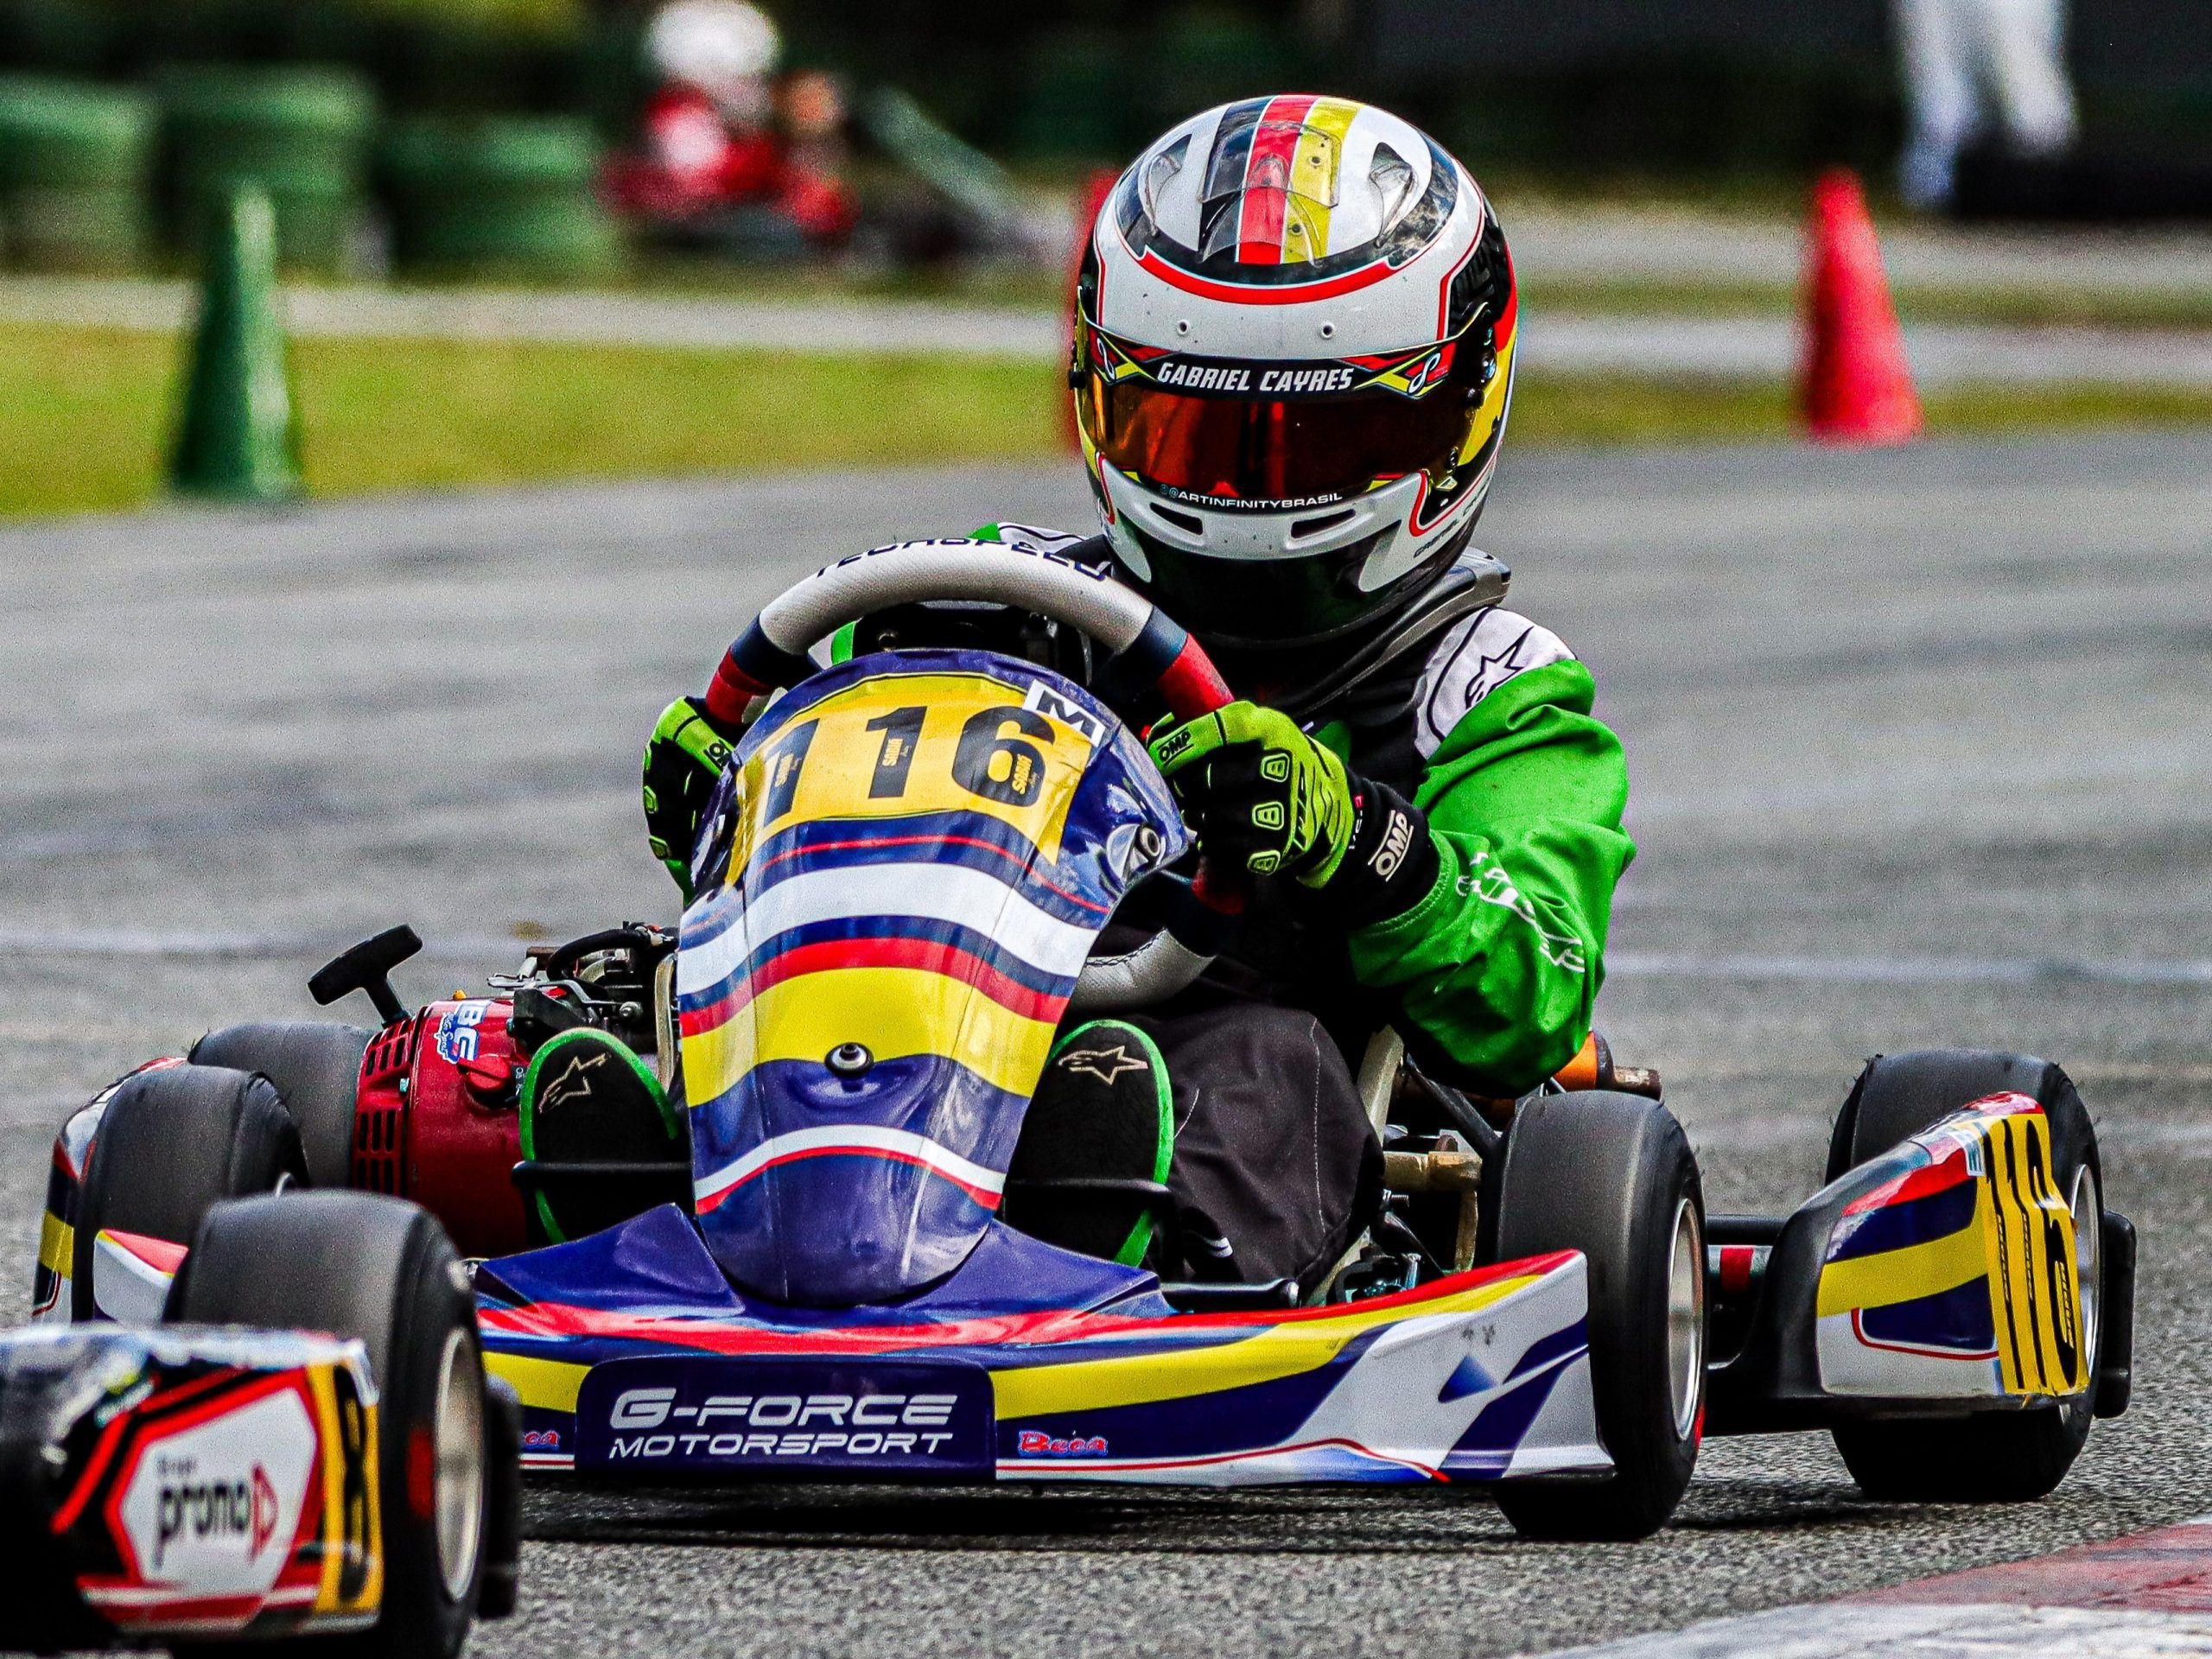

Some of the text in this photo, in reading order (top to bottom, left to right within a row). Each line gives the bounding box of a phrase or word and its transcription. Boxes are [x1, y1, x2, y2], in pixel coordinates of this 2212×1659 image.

[1158, 362, 1354, 392] GABRIEL CAYRES
[1169, 487, 1343, 509] @ARTINFINITYBRASIL
[1036, 690, 1097, 740] M
[1159, 730, 1192, 762] OMP
[764, 705, 1056, 827] 116
[1376, 812, 1409, 876] OMP
[609, 1388, 958, 1429] G-FORCE
[608, 1433, 953, 1459] MOTORSPORT
